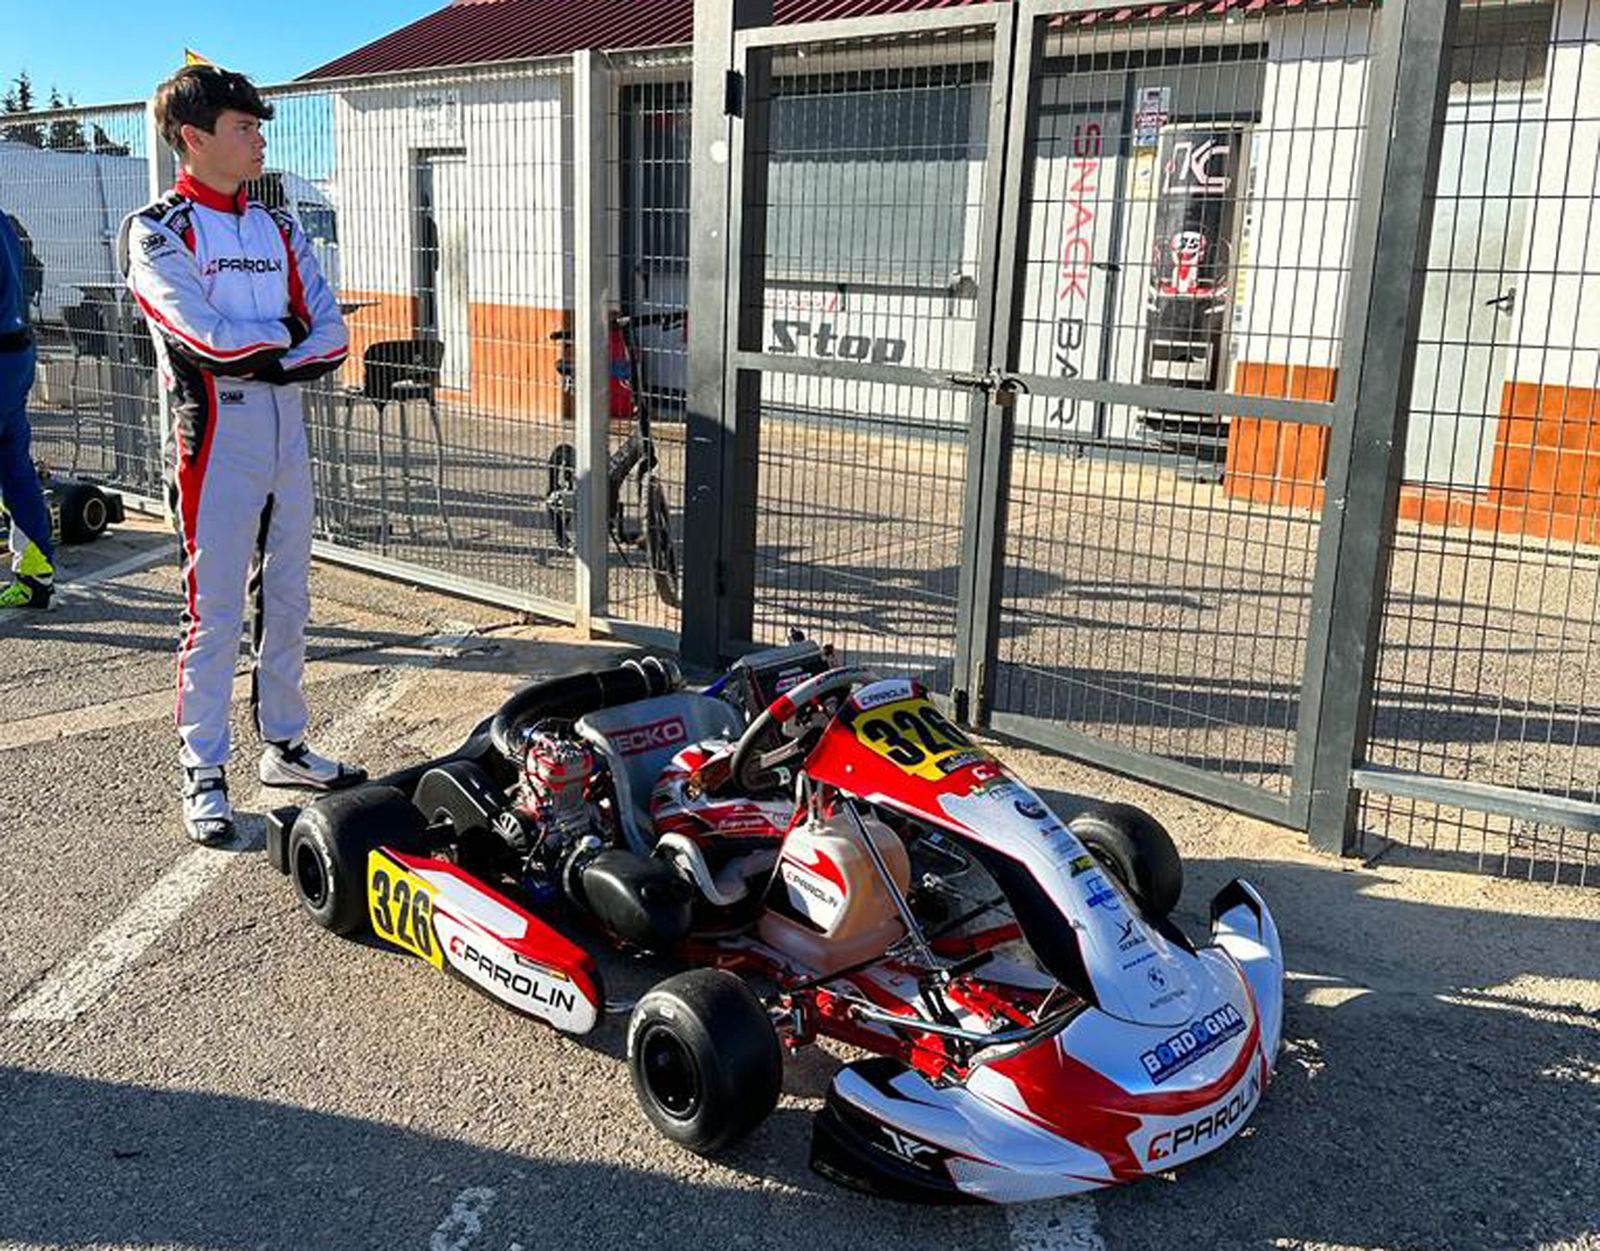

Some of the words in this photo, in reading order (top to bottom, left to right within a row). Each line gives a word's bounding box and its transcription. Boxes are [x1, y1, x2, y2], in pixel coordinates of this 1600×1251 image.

[1060, 123, 1101, 300] SNACK
[768, 320, 906, 363] Stop
[1050, 317, 1084, 424] BAR
[862, 706, 969, 766] 326
[373, 870, 433, 957] 326
[464, 944, 576, 1013] PAROLIN
[1143, 1004, 1241, 1075] BORDOGNA
[1172, 1066, 1261, 1154] PAROLIN
